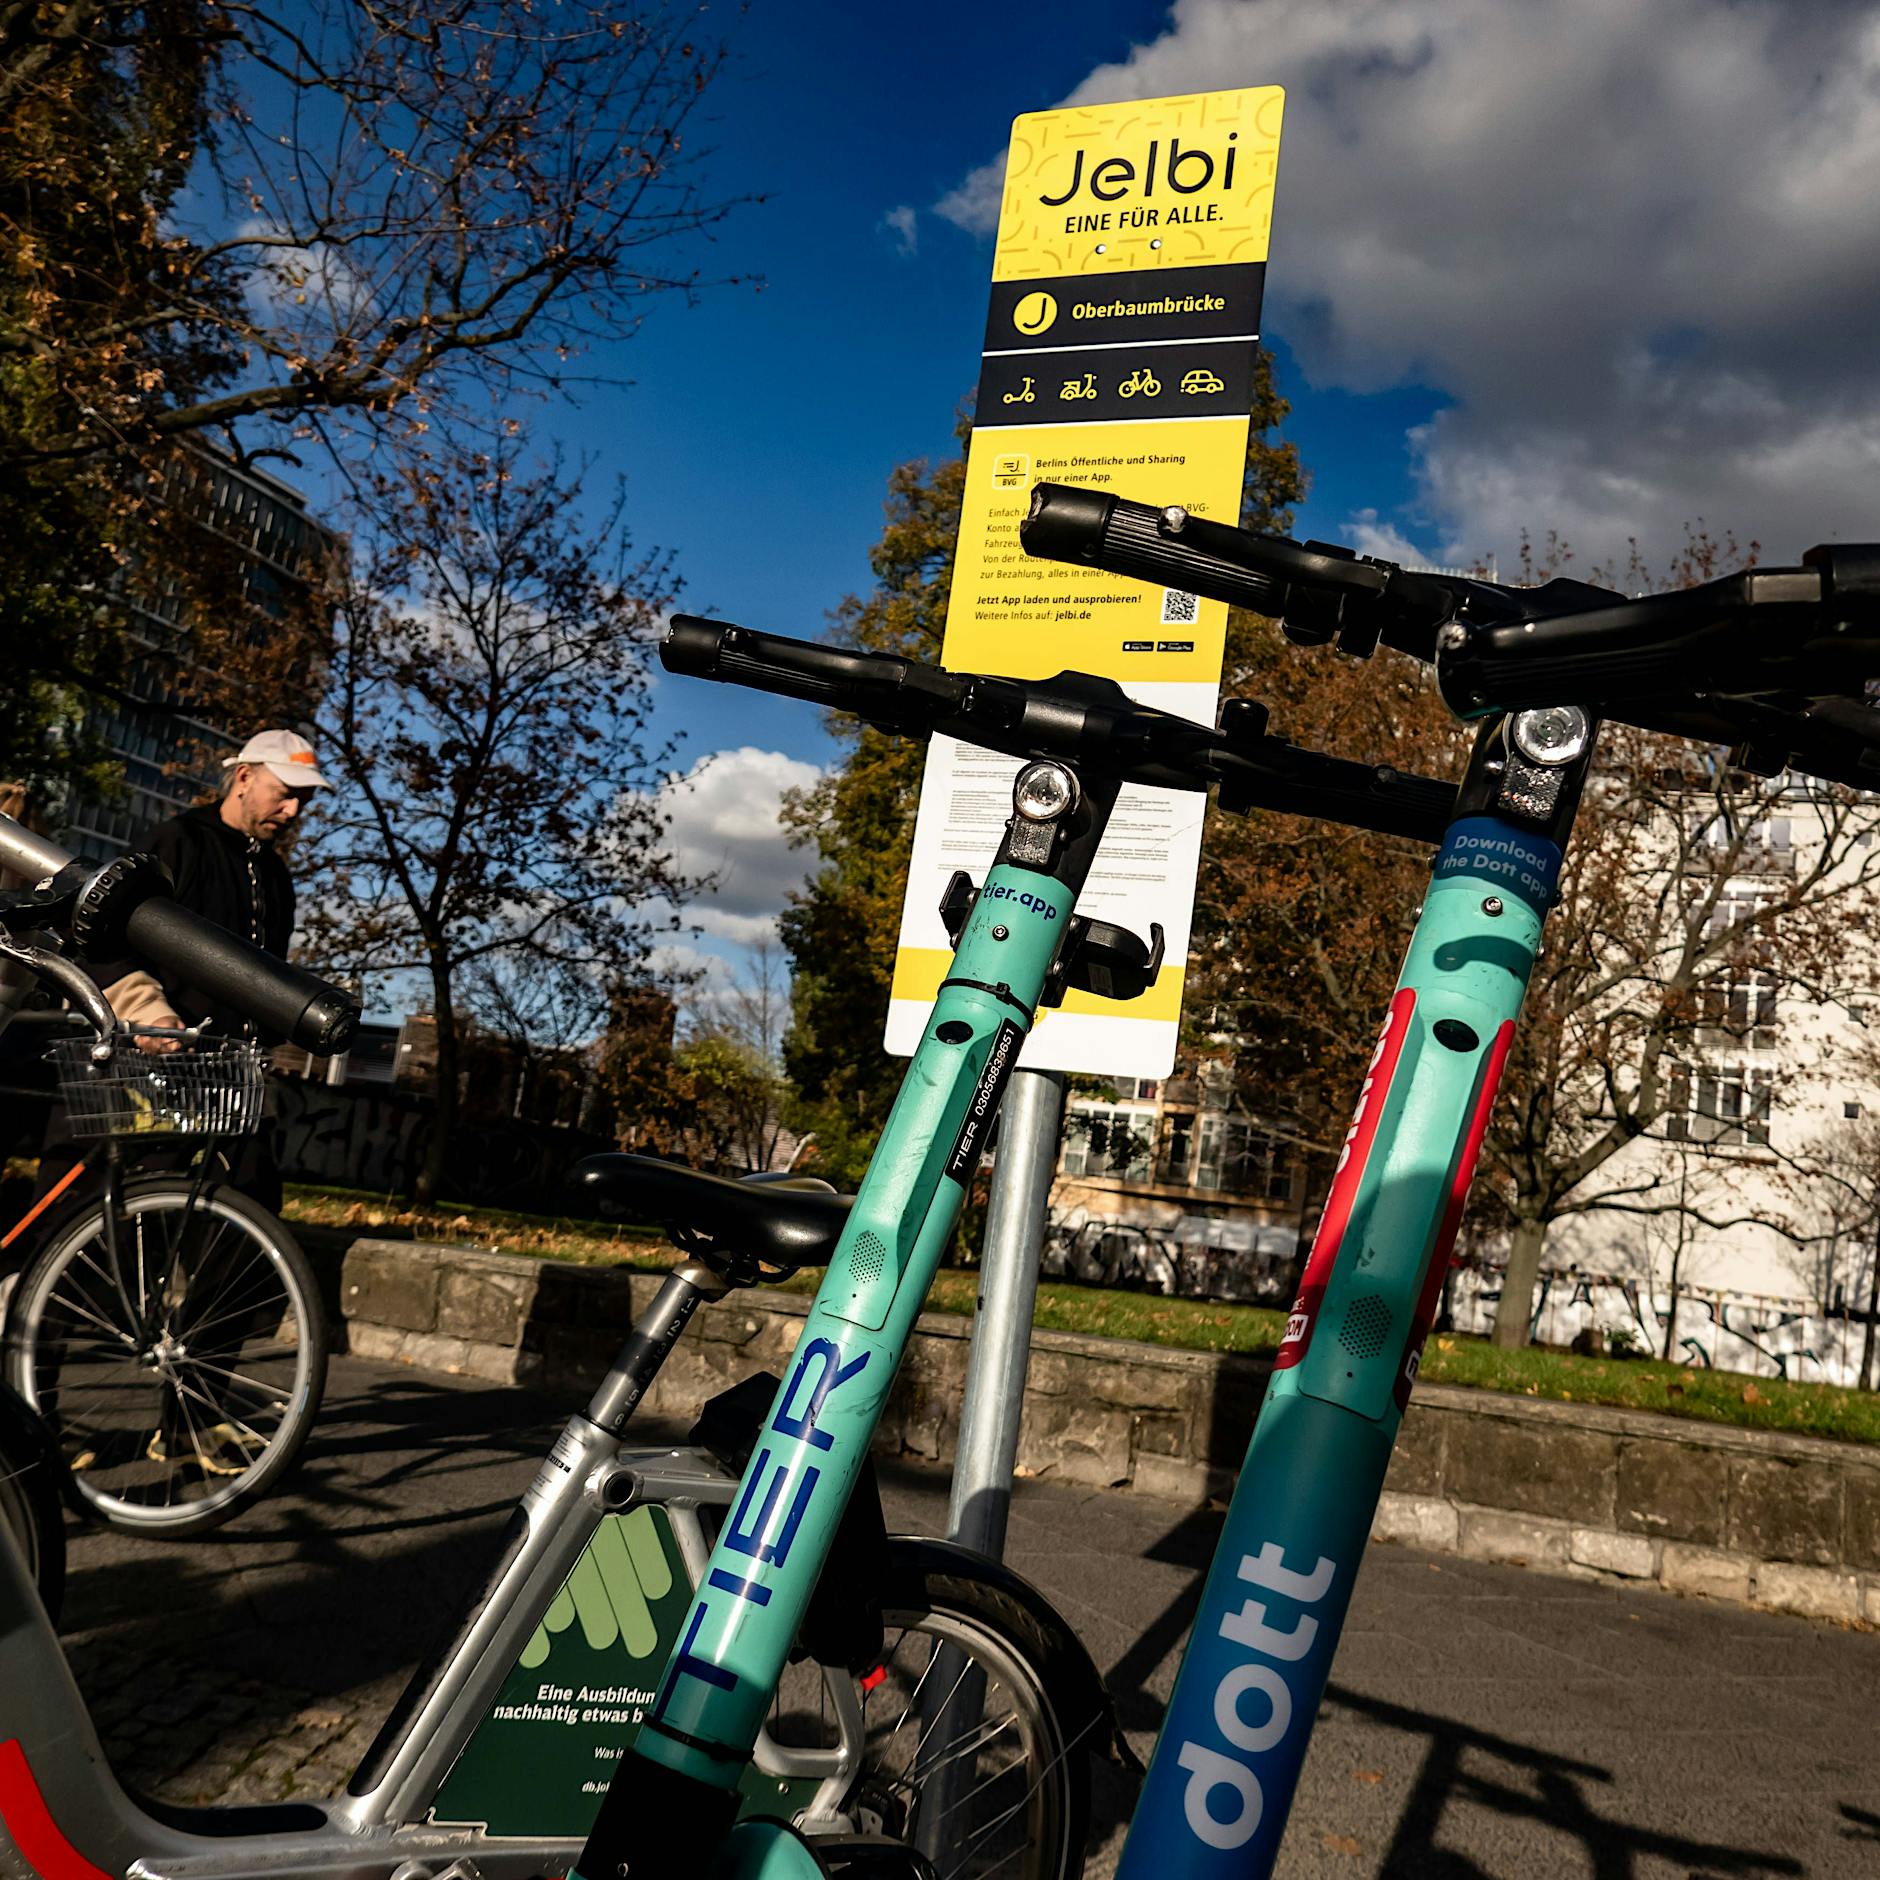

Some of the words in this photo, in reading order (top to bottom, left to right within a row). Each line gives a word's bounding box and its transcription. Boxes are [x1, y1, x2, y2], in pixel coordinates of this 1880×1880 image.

[1039, 132, 1238, 206] Jelbi
[1065, 213, 1112, 233] EINE
[1119, 207, 1159, 229] FÜR
[1166, 204, 1224, 225] ALLE.
[1072, 294, 1225, 320] Oberbaumbrücke
[1036, 458, 1068, 468] Berlins
[1071, 456, 1124, 467] Öffentliche
[1127, 455, 1146, 465] und
[1148, 453, 1186, 465] Sharing
[1002, 478, 1017, 486] BVG
[1046, 474, 1062, 483] nur
[1064, 474, 1088, 483] einer
[1091, 473, 1113, 483] App.
[989, 508, 1020, 518] Einfach
[987, 524, 1012, 533] Konto
[982, 555, 999, 563] Von
[1001, 554, 1016, 563] der
[980, 571, 994, 579] zur
[996, 569, 1045, 580] Bezahlung,
[1047, 569, 1069, 578] alles
[1071, 569, 1080, 578] in
[1082, 569, 1105, 578] einer
[977, 596, 999, 604] Jetzt
[1002, 595, 1021, 606] App
[1023, 595, 1050, 604] laden
[1052, 594, 1071, 604] und
[1073, 594, 1142, 605] ausprobieren!
[974, 611, 1009, 620] Weitere
[1010, 610, 1033, 620] Infos
[1035, 610, 1053, 620] auf:
[1055, 610, 1092, 621] jelbi.de
[1454, 835, 1548, 872] Download
[1443, 854, 1469, 869] the
[1472, 854, 1518, 877] Dott
[1520, 872, 1548, 898] app
[983, 882, 1057, 920] tier.app
[953, 1121, 979, 1170] TIER
[975, 1027, 1015, 1116] 03056838651
[655, 1337, 871, 1721] TIER
[537, 1684, 573, 1701] Eine
[576, 1686, 656, 1705] Ausbildun
[1177, 1541, 1336, 1850] dott
[493, 1703, 579, 1725] nachhaltig
[582, 1708, 629, 1724] etwas
[594, 1746, 615, 1760] Was
